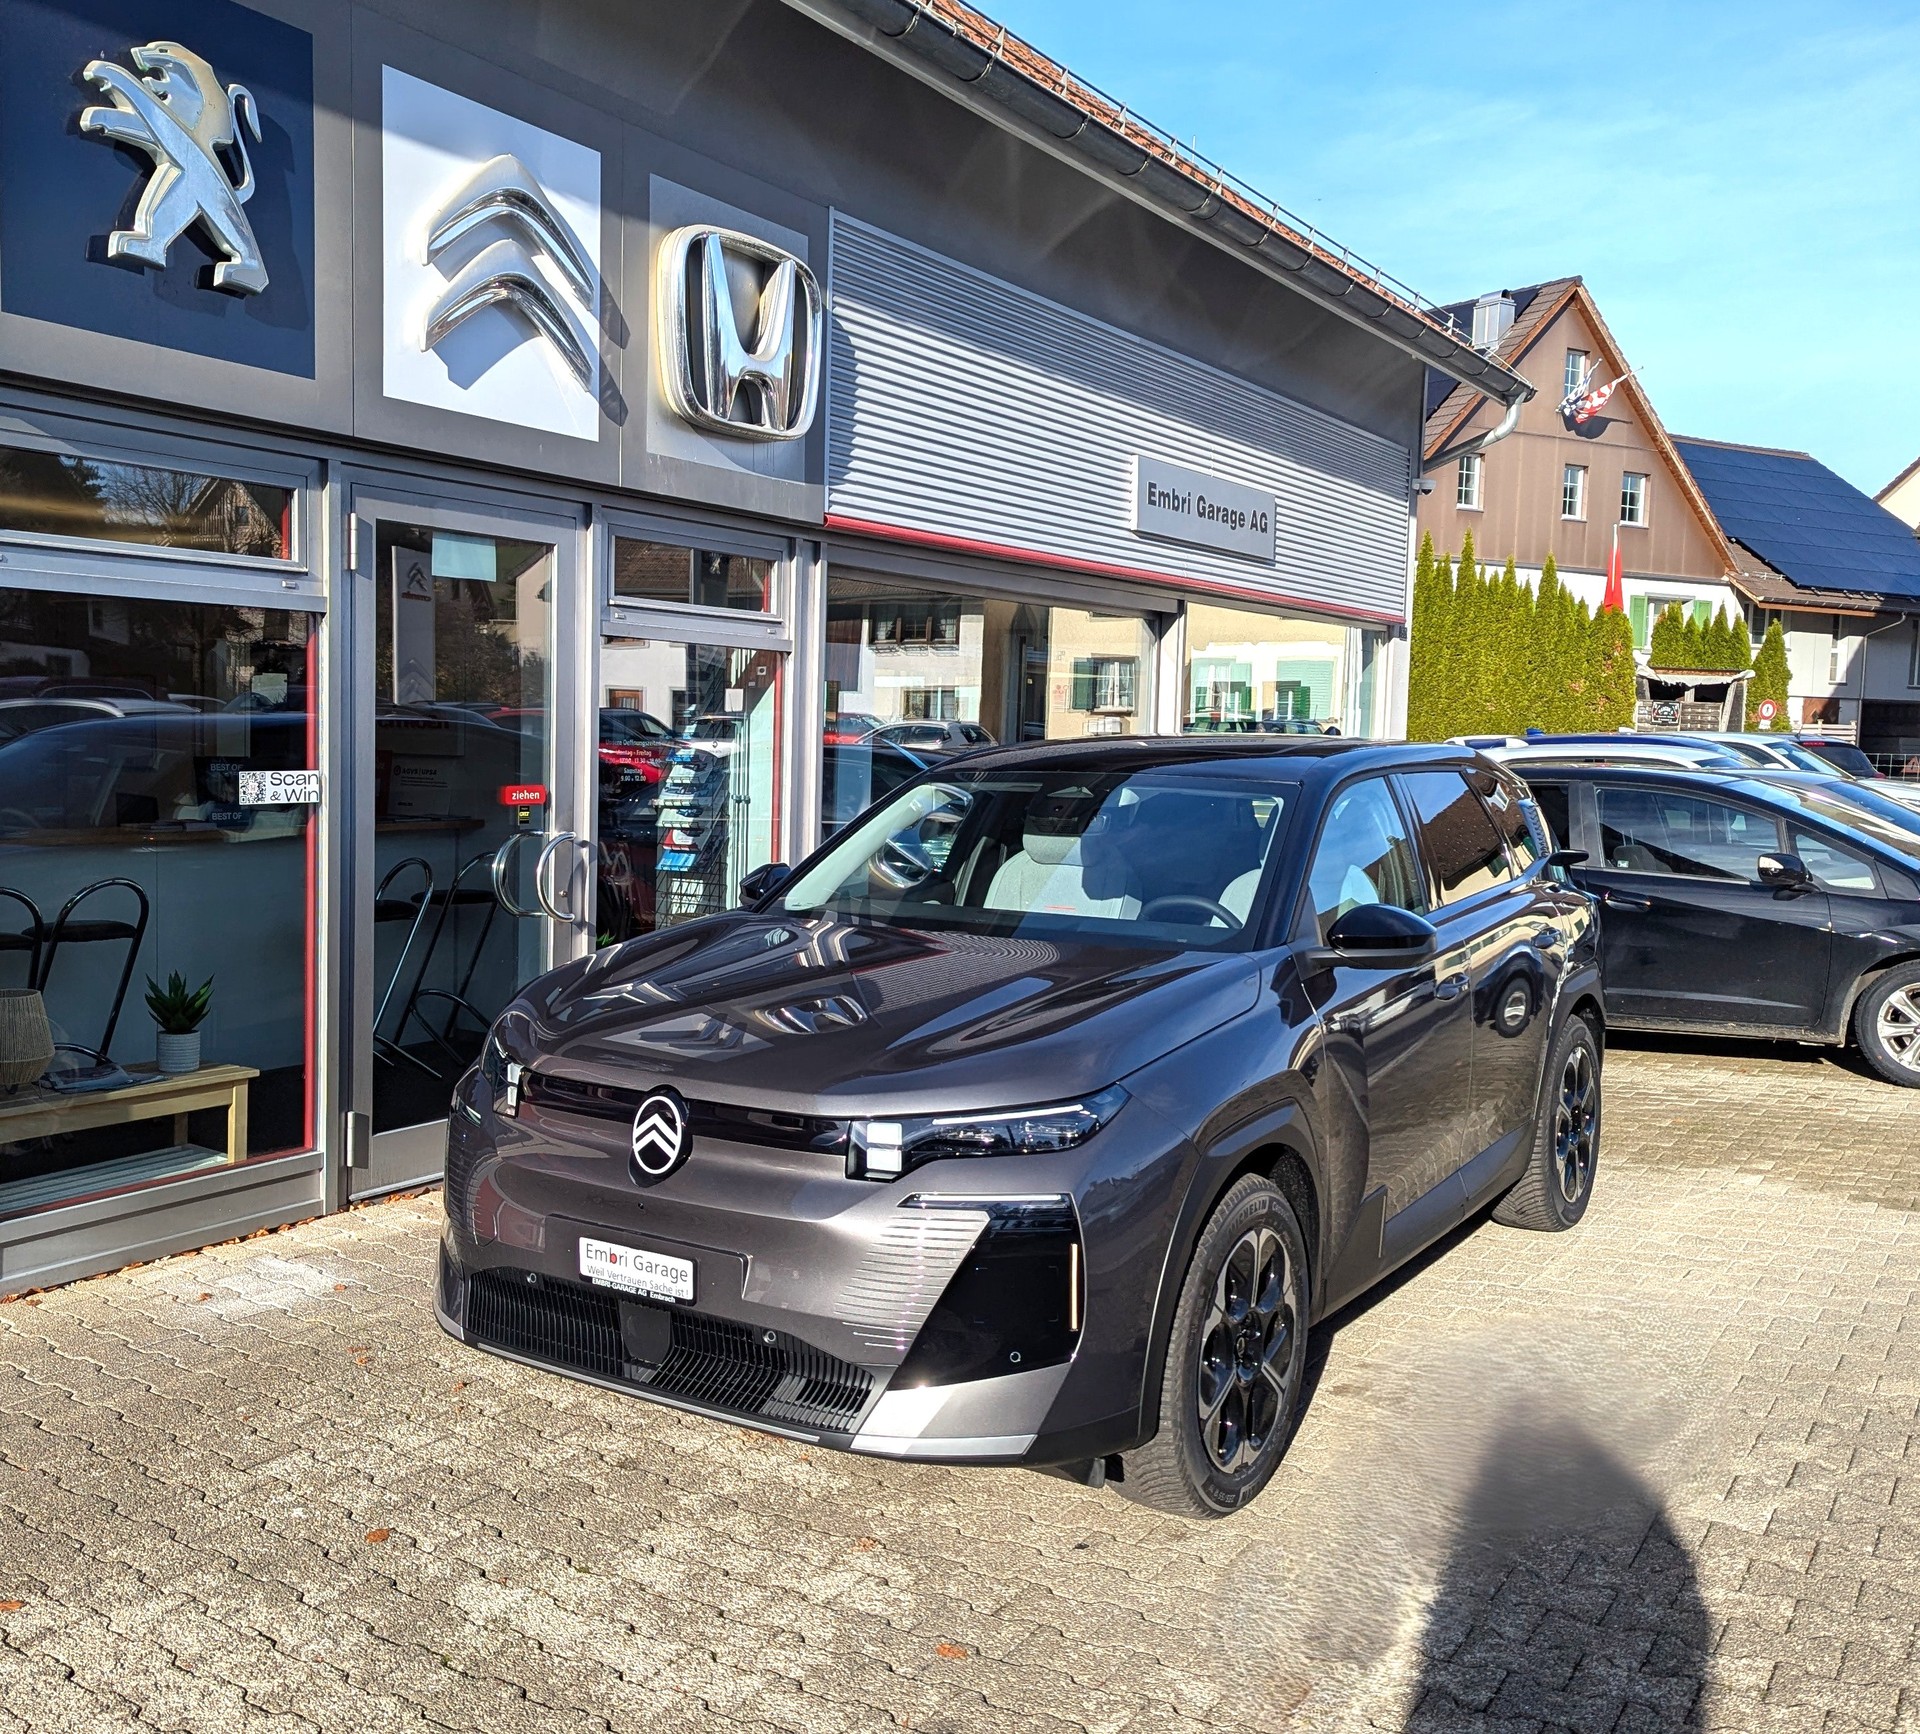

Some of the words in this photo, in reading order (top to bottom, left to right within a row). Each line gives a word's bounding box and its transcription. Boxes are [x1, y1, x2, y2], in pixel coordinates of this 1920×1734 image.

[1147, 481, 1191, 514] Embri
[1196, 495, 1245, 531] Garage
[1250, 510, 1268, 534] AG
[210, 763, 229, 771] BEST
[269, 772, 319, 786] Scan
[269, 791, 281, 801] &
[284, 787, 319, 802] Win
[511, 790, 540, 800] ziehen
[211, 812, 232, 820] BEST
[233, 812, 242, 820] OF
[586, 1243, 628, 1267] Embri
[633, 1255, 688, 1284] Garage
[587, 1265, 605, 1277] Weil
[607, 1269, 647, 1288] Vertrauen
[650, 1280, 673, 1294] Sache
[675, 1288, 684, 1298] ist
[592, 1277, 637, 1295] EMBRI-GARAGE
[637, 1289, 647, 1297] AG
